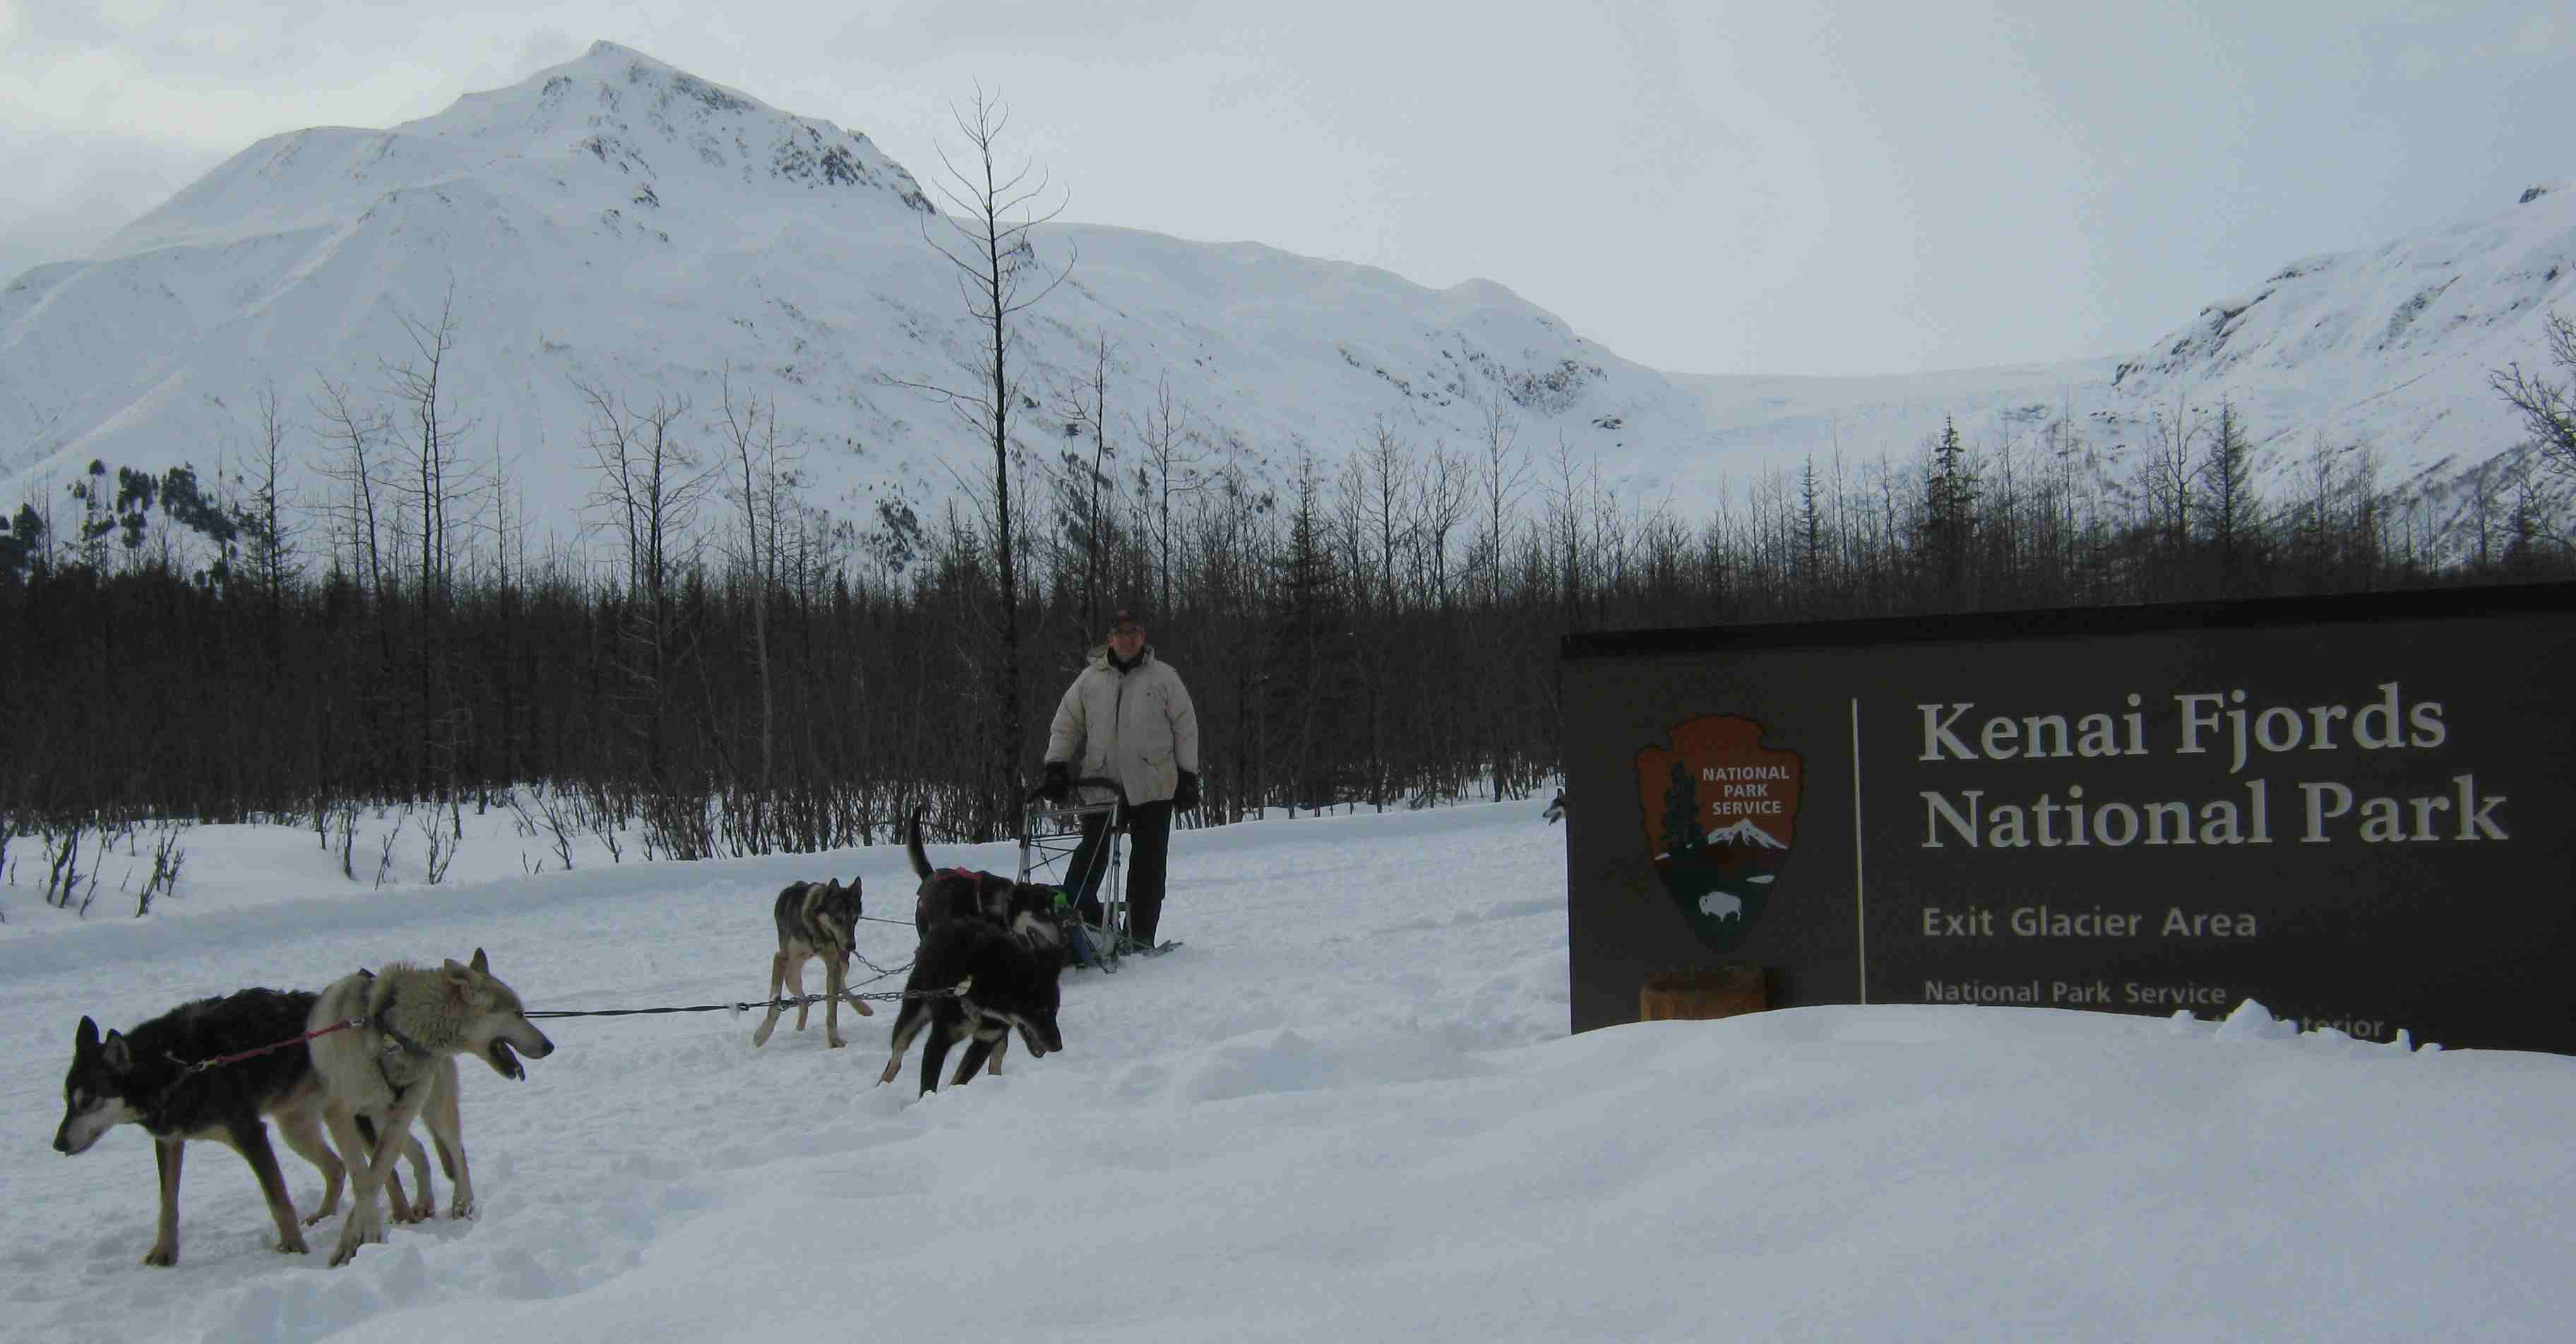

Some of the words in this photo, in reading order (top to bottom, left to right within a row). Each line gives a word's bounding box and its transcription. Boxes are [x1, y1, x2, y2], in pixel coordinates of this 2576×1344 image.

[1917, 693, 2149, 762] Kenai
[2175, 682, 2447, 774] Fjords
[1703, 766, 1790, 781] NATIONAL
[1724, 784, 1768, 797] PARK
[1712, 800, 1782, 815] SERVICE
[1919, 779, 2272, 849] National
[2299, 774, 2510, 844] Park
[1924, 906, 1993, 937] Exit
[2010, 905, 2142, 937] Glacier
[2161, 907, 2257, 937] Area
[1924, 980, 2039, 1003] National
[2052, 980, 2112, 1003] Park
[2125, 982, 2226, 1004] Service
